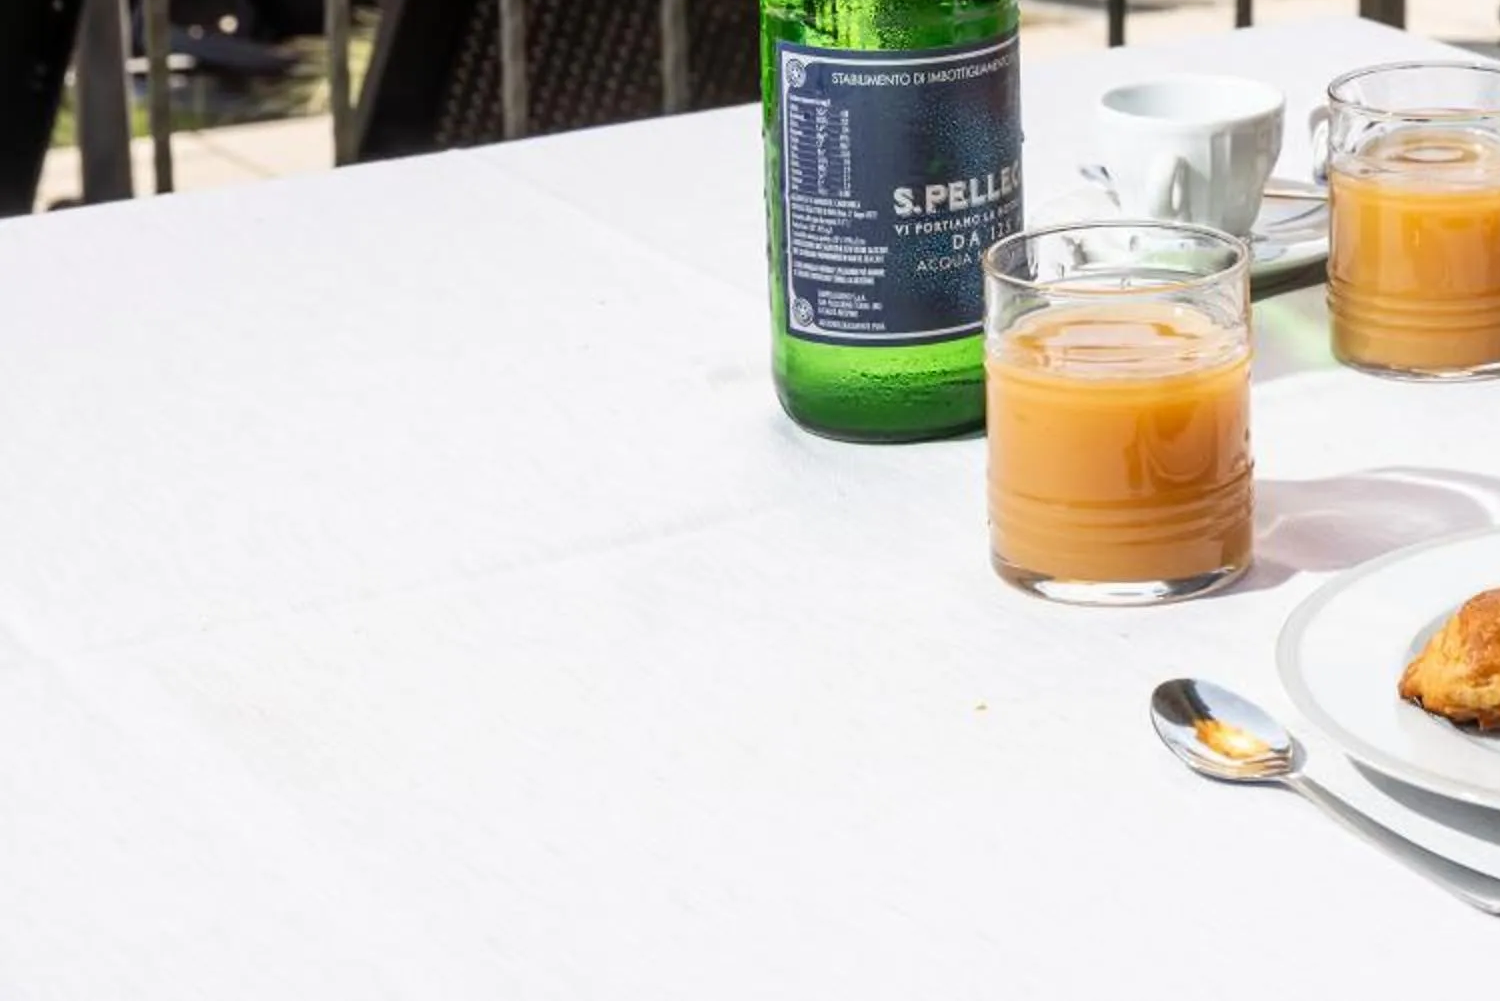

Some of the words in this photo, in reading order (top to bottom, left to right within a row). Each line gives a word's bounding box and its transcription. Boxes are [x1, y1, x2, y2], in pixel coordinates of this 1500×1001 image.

[831, 72, 910, 87] STABILIMENTO
[895, 224, 910, 236] VI
[914, 214, 981, 235] PORTIAMO
[952, 230, 981, 251] DA
[916, 252, 973, 272] ACQUA
